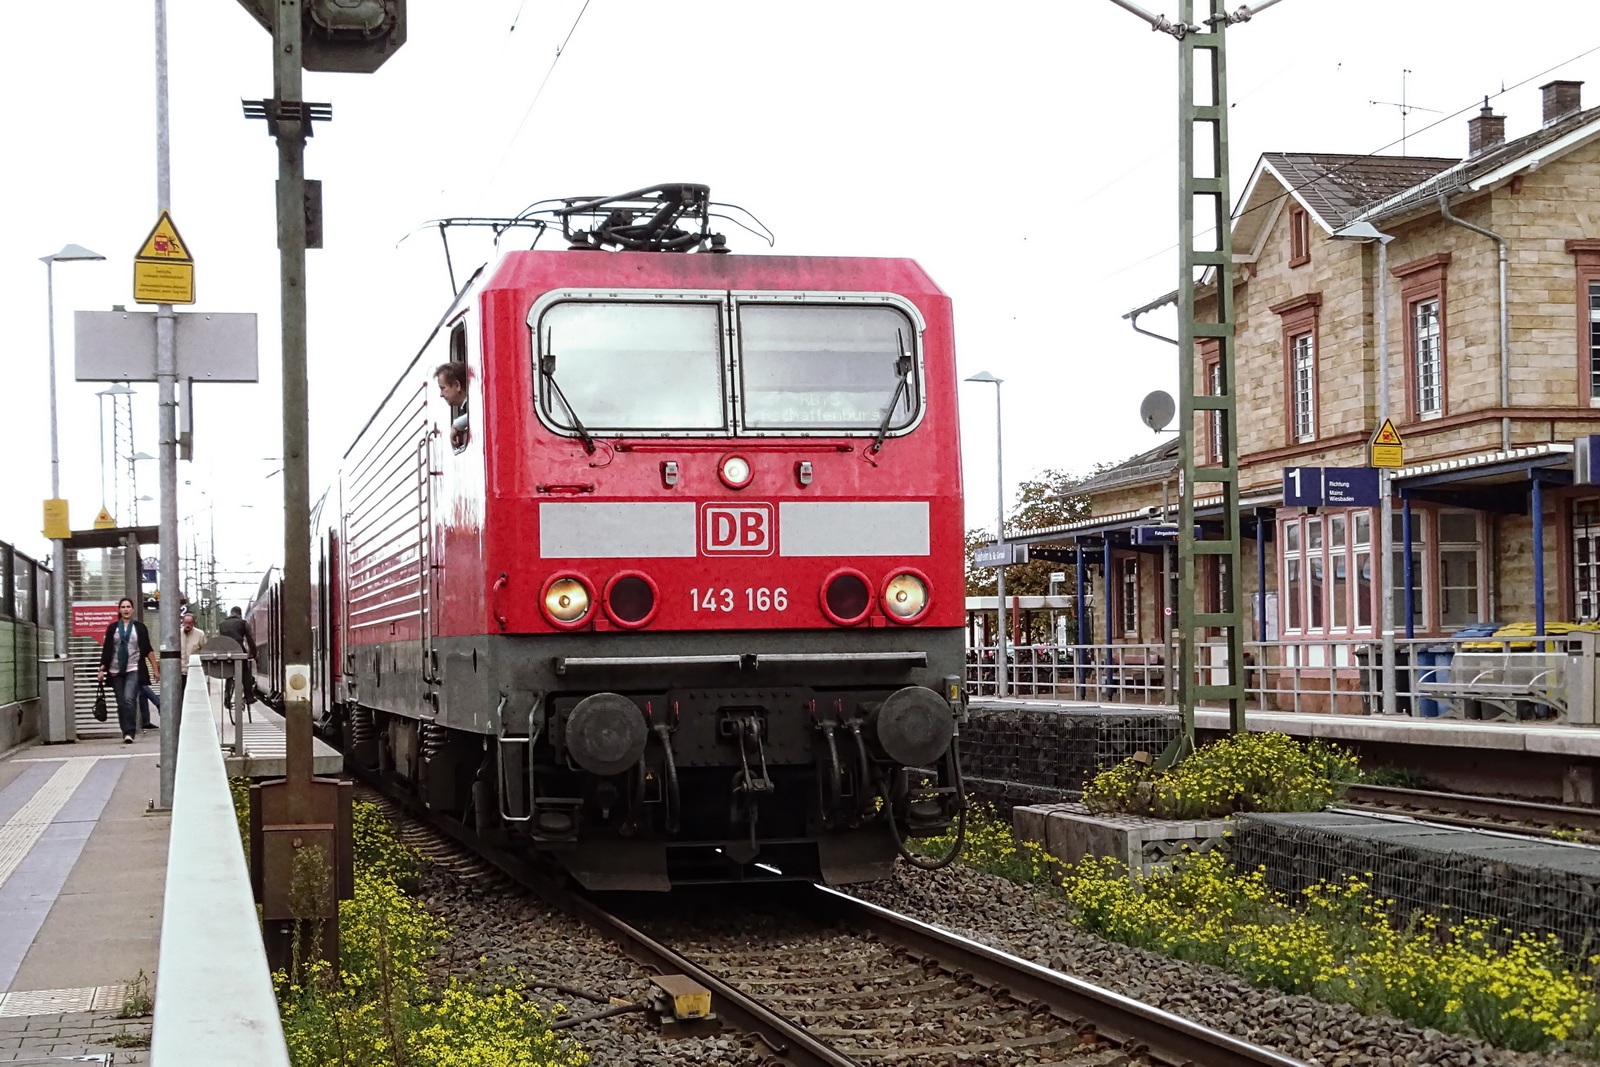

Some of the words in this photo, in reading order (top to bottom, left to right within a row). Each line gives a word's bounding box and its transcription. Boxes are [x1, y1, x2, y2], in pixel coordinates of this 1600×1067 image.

[1288, 468, 1301, 497] 1
[711, 511, 765, 547] DB
[690, 588, 734, 612] 143
[745, 587, 788, 612] 166
